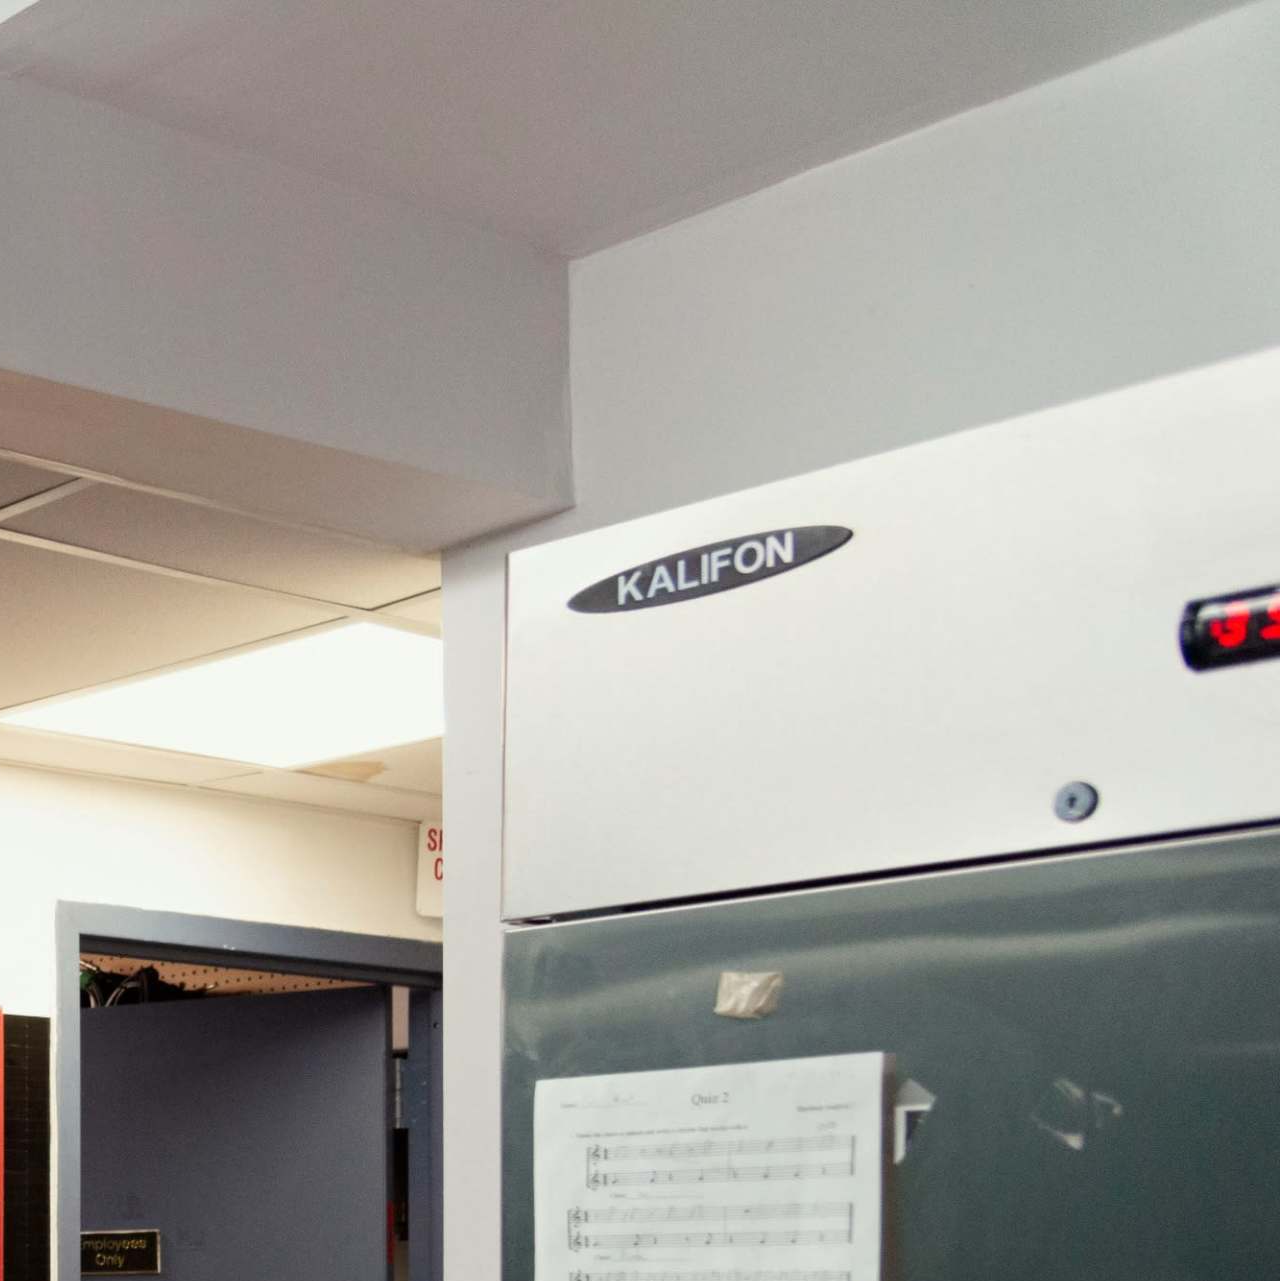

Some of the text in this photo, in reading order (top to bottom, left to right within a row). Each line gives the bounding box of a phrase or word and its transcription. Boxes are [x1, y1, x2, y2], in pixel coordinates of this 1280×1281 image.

[616, 530, 795, 605] KALIFON
[81, 1237, 147, 1251] mployees
[95, 1253, 125, 1268] Only
